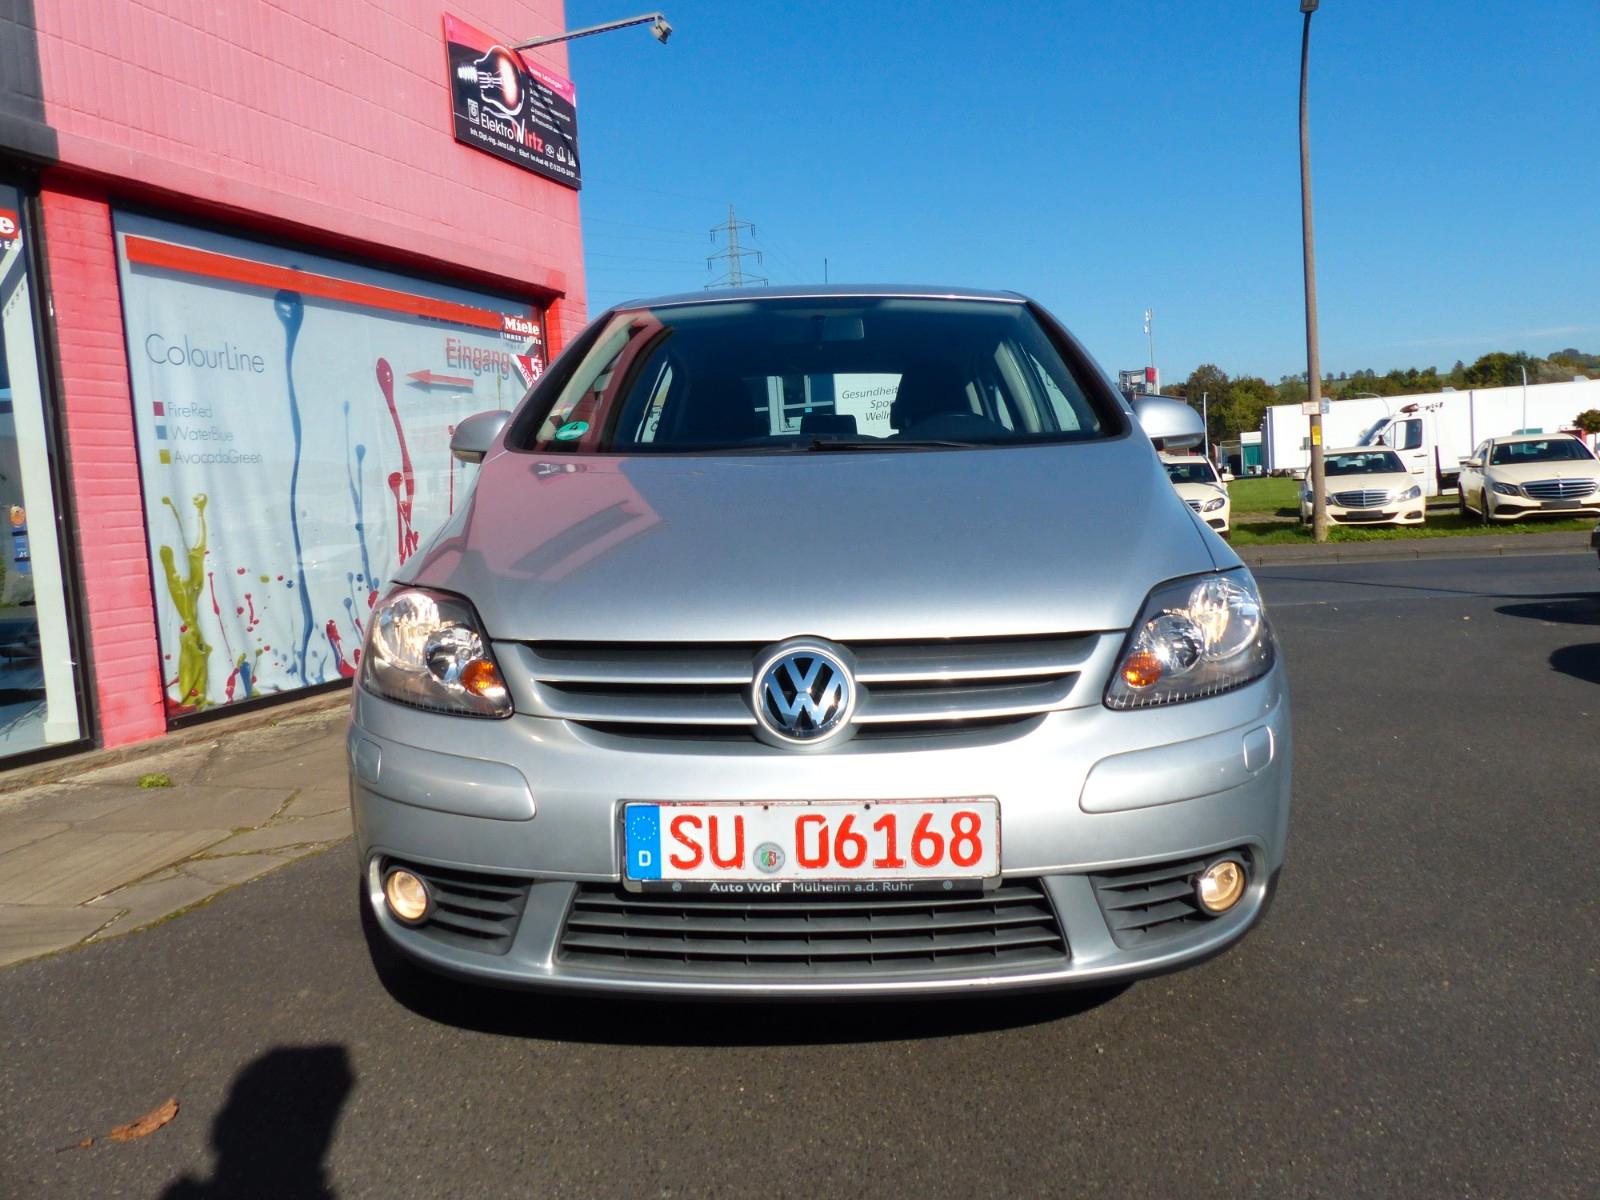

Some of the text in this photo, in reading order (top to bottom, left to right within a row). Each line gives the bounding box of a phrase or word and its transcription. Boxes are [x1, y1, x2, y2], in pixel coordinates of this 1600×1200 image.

[503, 316, 540, 336] Miele
[144, 333, 265, 374] ColourLine
[446, 337, 510, 376] Eingang
[870, 399, 891, 410] Spo
[669, 811, 982, 870] SU 06168
[638, 850, 651, 867] D
[710, 880, 914, 893] Auto Wolf Mülheim a.d. Ruhr
